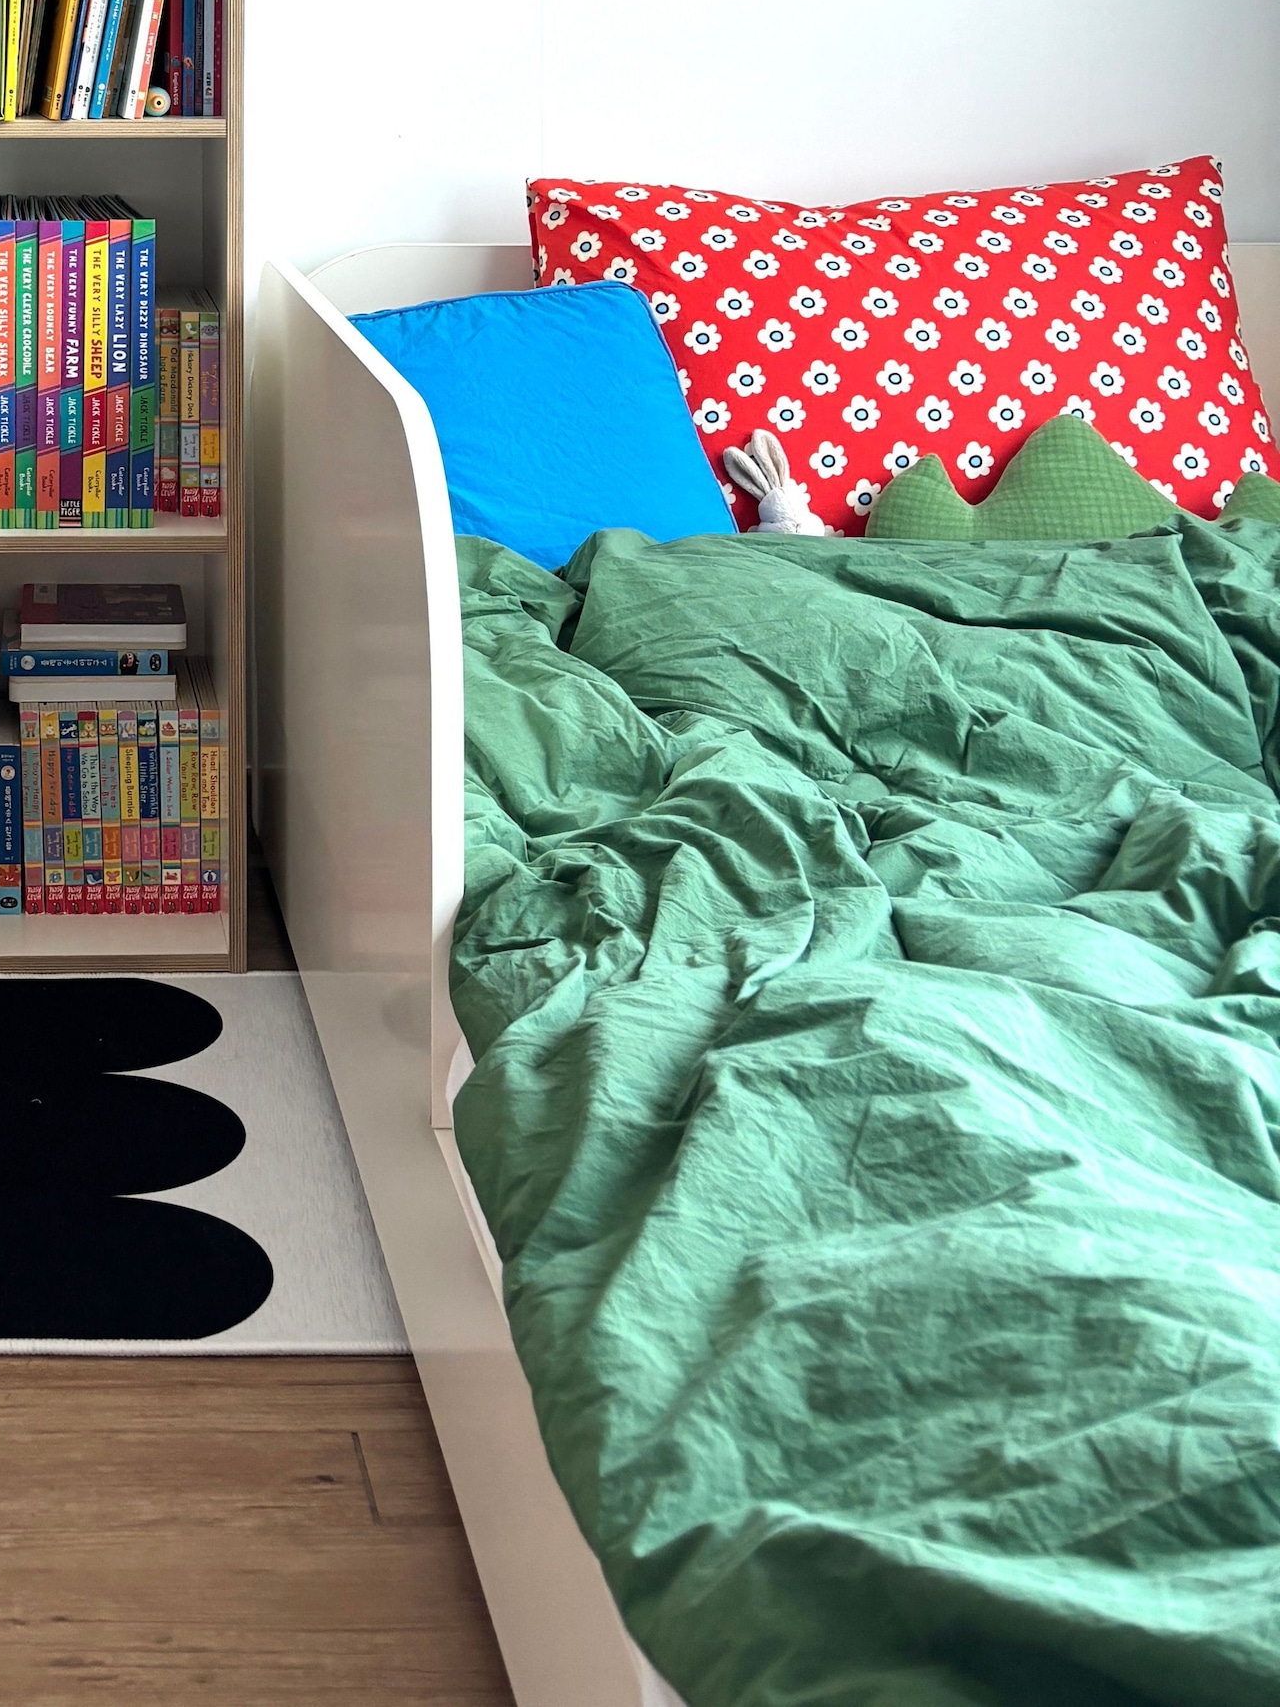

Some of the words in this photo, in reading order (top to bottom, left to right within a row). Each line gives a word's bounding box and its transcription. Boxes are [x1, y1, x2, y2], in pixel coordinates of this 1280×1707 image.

[22, 247, 32, 264] THE
[46, 251, 55, 270] THE
[68, 249, 77, 268] THE
[93, 249, 101, 269] THE
[116, 250, 125, 270] THE
[140, 249, 148, 268] THE
[22, 267, 32, 290] VERY
[46, 274, 55, 299] VERY
[68, 272, 77, 298] VERY
[93, 274, 101, 302] VERY
[116, 274, 125, 300] VERY
[140, 272, 148, 297] VERY
[22, 293, 32, 325] CLEVER
[46, 302, 55, 341] BOUNCY
[68, 302, 77, 334] FUNNY
[93, 308, 101, 336] SILLY
[116, 304, 125, 329] LAZY
[140, 300, 148, 329] DIZZY
[22, 328, 32, 376] CROCODILE
[46, 347, 55, 374] BEAR
[66, 339, 79, 378] FARM
[91, 339, 102, 379] SHEEP
[112, 334, 127, 372] LION
[140, 333, 148, 380] DINOSAUR
[186, 377, 194, 400] Dickory
[0, 396, 8, 414] JACK
[46, 397, 54, 416] JACK
[68, 397, 76, 415] JACK
[92, 397, 100, 416] JACK
[115, 395, 123, 413] JACK
[140, 396, 148, 414] JACK
[0, 417, 8, 443] TICKLE
[46, 419, 54, 445] TICKLE
[68, 418, 76, 444] TICKLE
[92, 419, 100, 445] TICKLE
[115, 416, 123, 442] TICKLE
[140, 417, 148, 443] TICKLE
[61, 500, 81, 508] LITTLE
[61, 508, 81, 516] TIGER
[48, 751, 56, 778] Happy
[81, 753, 88, 765] We
[125, 749, 133, 784] Sleeping
[149, 748, 157, 781] Twinkle,
[82, 768, 89, 779] Go
[82, 791, 90, 815] School
[126, 785, 134, 818] Bunnies
[140, 786, 148, 803] Star
[150, 783, 158, 817] Twinkle,
